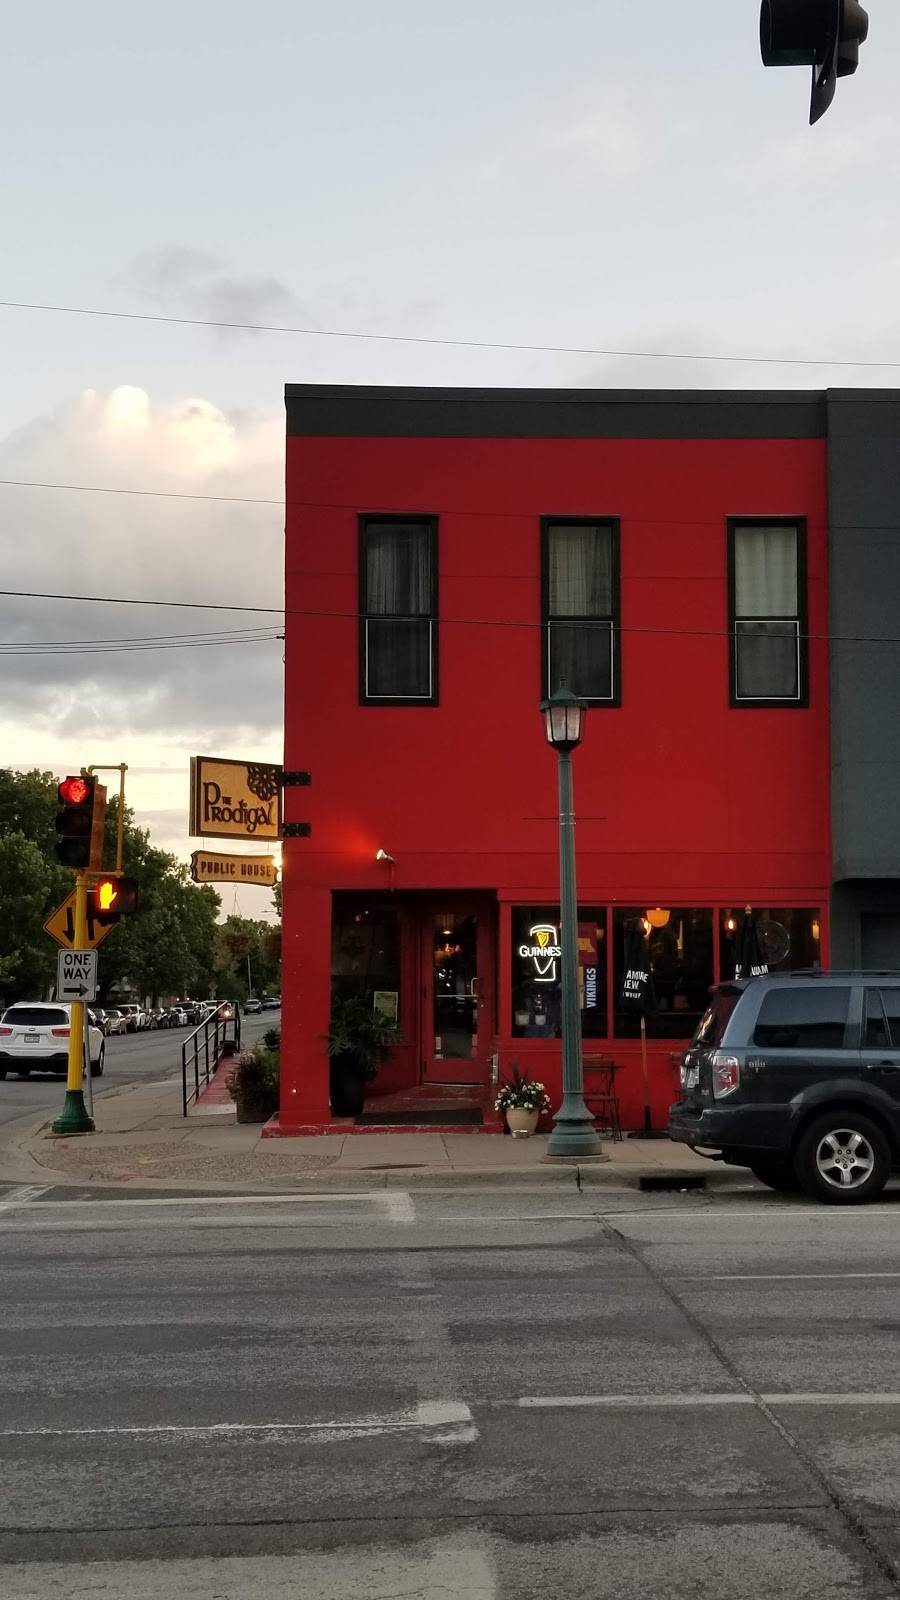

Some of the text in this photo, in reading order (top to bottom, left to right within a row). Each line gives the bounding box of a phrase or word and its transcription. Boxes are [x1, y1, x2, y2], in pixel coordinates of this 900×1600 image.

[201, 861, 272, 877] PUBLIC HOUSE
[519, 945, 562, 957] GUINNES
[64, 953, 92, 966] ONE
[63, 967, 92, 980] WAY
[586, 967, 597, 1009] VIKINGS
